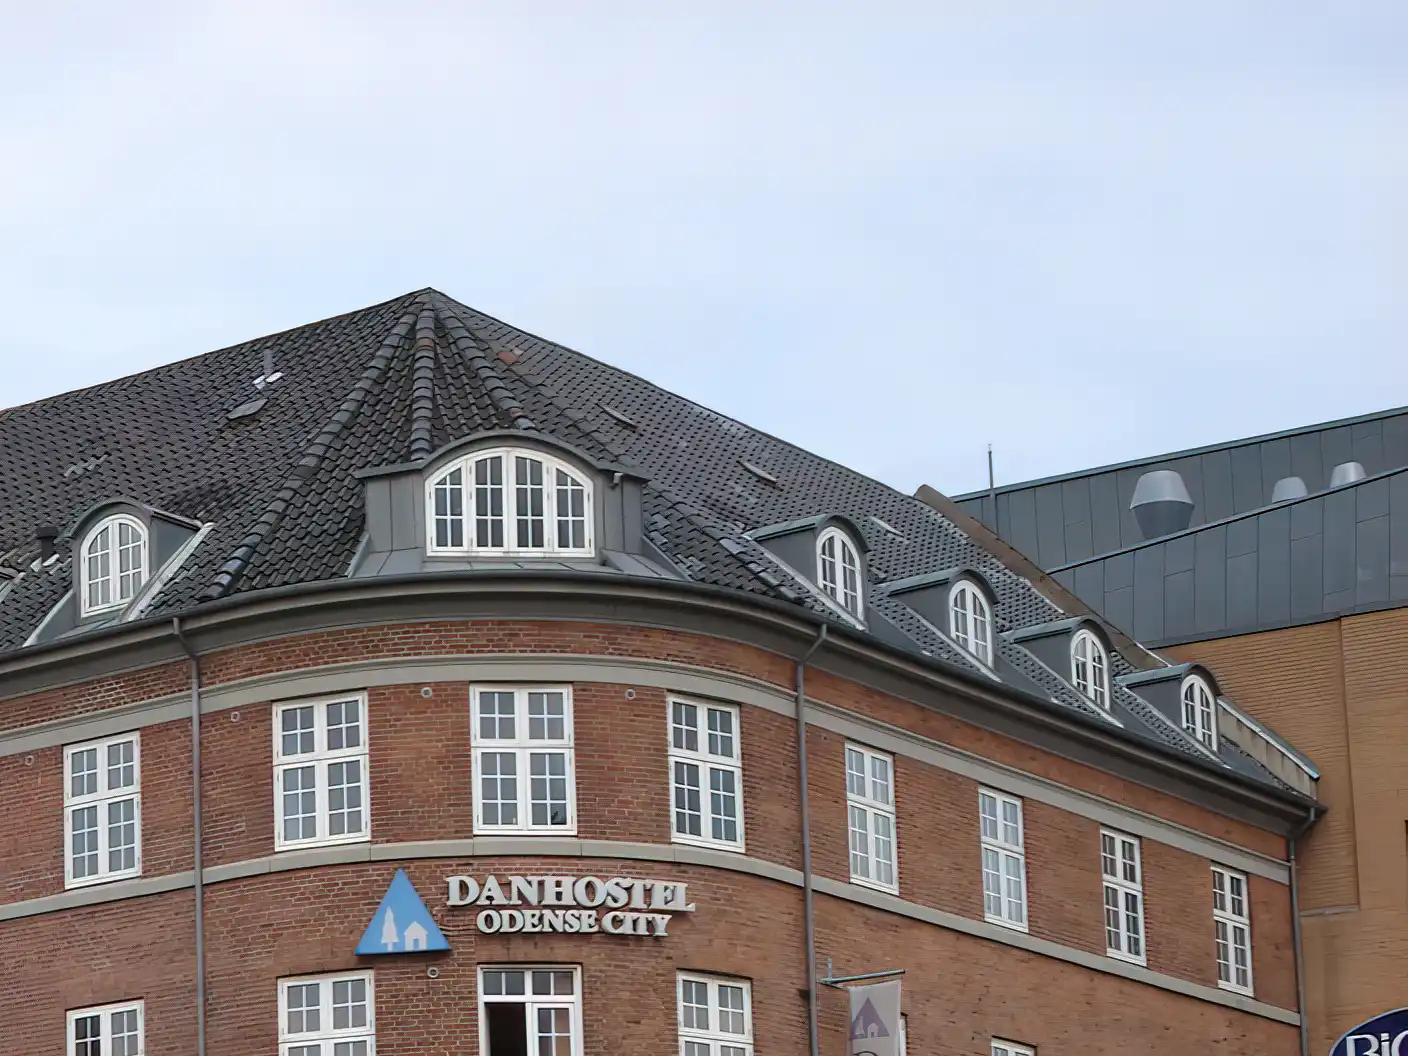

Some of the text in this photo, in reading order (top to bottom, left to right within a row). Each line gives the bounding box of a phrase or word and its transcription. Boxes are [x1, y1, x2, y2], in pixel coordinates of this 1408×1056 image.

[446, 876, 696, 911] DANHOSTEL
[477, 909, 673, 937] ODENSE CITY
